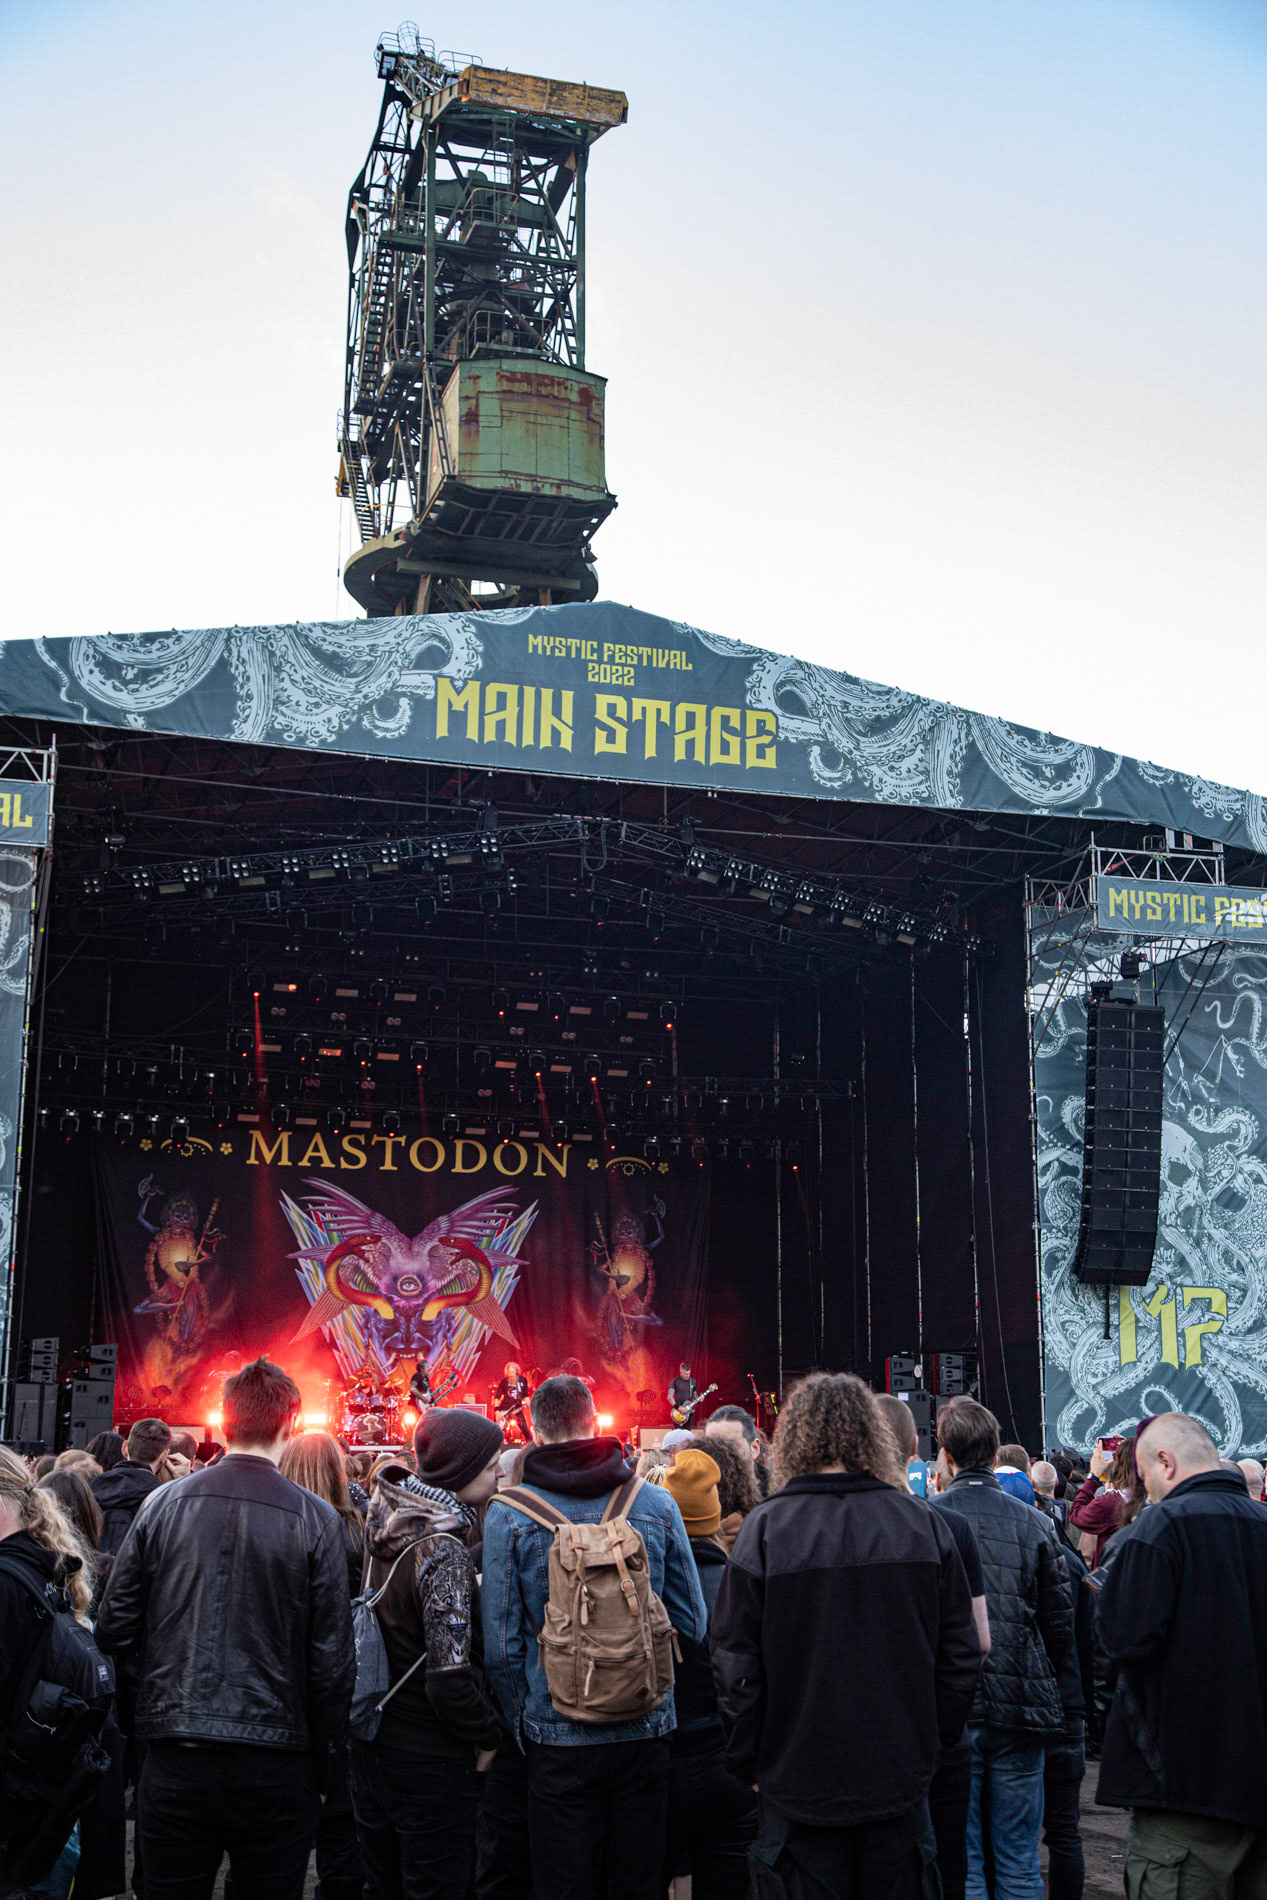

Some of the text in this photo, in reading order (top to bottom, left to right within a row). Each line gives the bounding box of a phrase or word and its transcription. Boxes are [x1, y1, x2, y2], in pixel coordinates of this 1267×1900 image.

[528, 634, 693, 671] MYSTIC FESTIVAL
[587, 662, 635, 686] 2022
[436, 677, 777, 770] MAIN STAGE
[1108, 887, 1267, 929] MYSTIC FES
[246, 1130, 572, 1178] MASTODON
